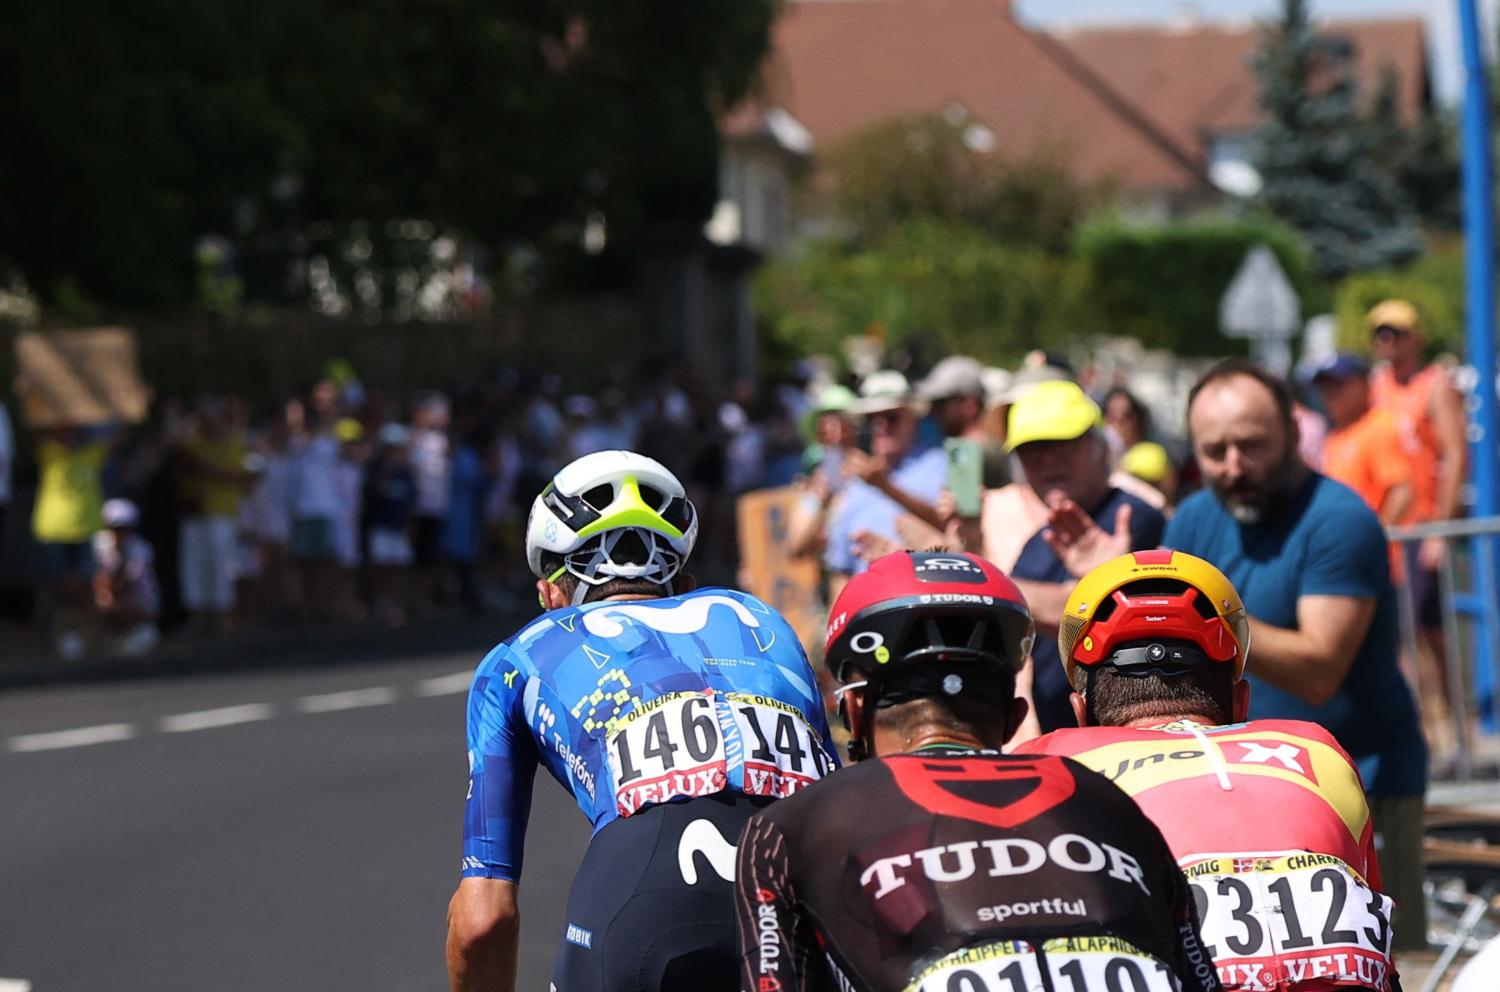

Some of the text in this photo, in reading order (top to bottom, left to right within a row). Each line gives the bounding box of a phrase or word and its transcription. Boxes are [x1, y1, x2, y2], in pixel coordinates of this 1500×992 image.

[931, 593, 984, 604] TUDOR
[627, 692, 682, 723] OLIVEIRA
[612, 697, 718, 786] 146
[714, 701, 744, 772] CANYON
[617, 767, 717, 815] VELUX
[859, 833, 1152, 899] TUDOR
[758, 904, 780, 974] TUDOR
[976, 898, 1088, 924] sportful
[1268, 868, 1388, 953] 123
[1283, 953, 1386, 992] VELUX
